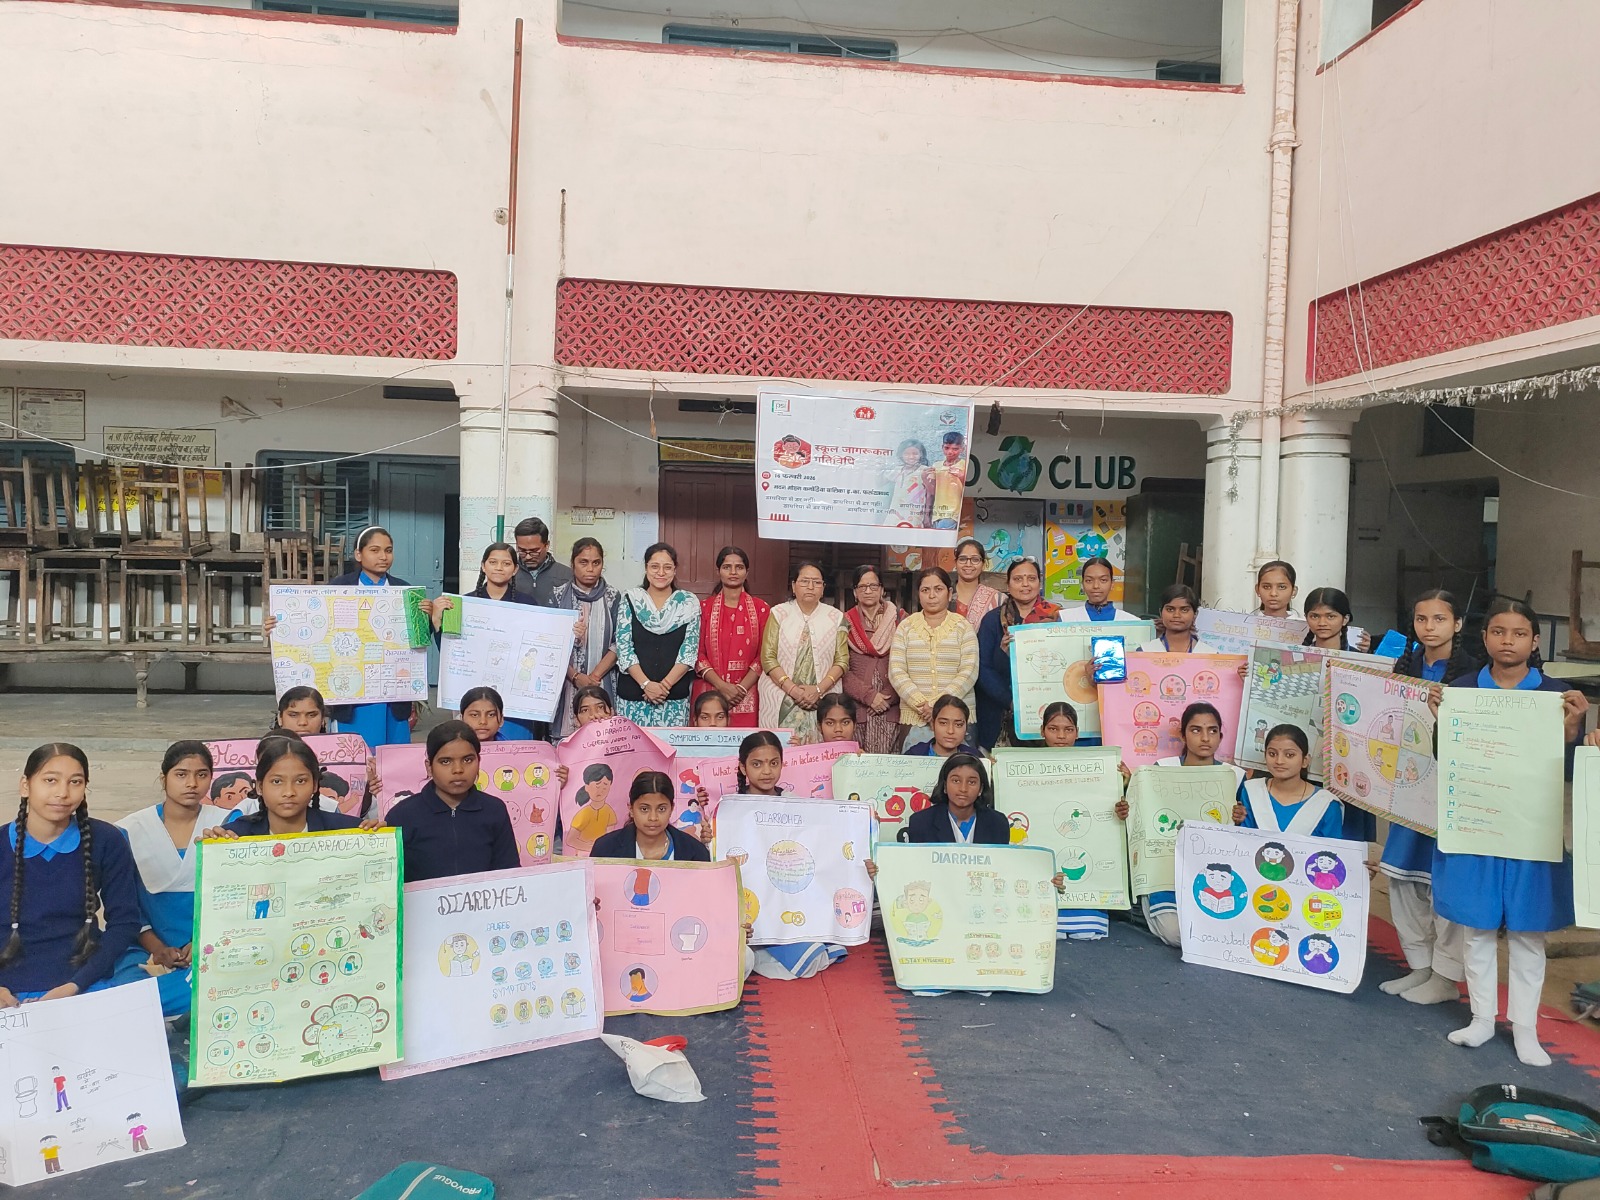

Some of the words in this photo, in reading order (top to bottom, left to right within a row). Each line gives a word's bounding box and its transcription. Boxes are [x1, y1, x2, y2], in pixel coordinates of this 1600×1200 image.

[814, 444, 840, 454] स्कूल
[814, 456, 855, 465] गतिविधि
[1049, 455, 1136, 490] CLUB
[1475, 695, 1537, 710] DIARRHEA
[610, 719, 628, 727] STOP
[1452, 718, 1458, 726] D
[669, 734, 700, 744] SYMPTOMS
[712, 766, 732, 776] What
[1009, 763, 1034, 776] STOP
[1040, 762, 1102, 774] DIARRHOEA
[1449, 772, 1456, 781] R
[1449, 785, 1454, 795] R
[1447, 810, 1454, 818] E
[225, 843, 272, 859] डायरिया
[932, 852, 991, 865] DIARRHEA
[438, 886, 528, 915] DIARRHEA
[493, 980, 536, 999] SYMPTOMS
[432, 1174, 482, 1195] PROVOGUE
